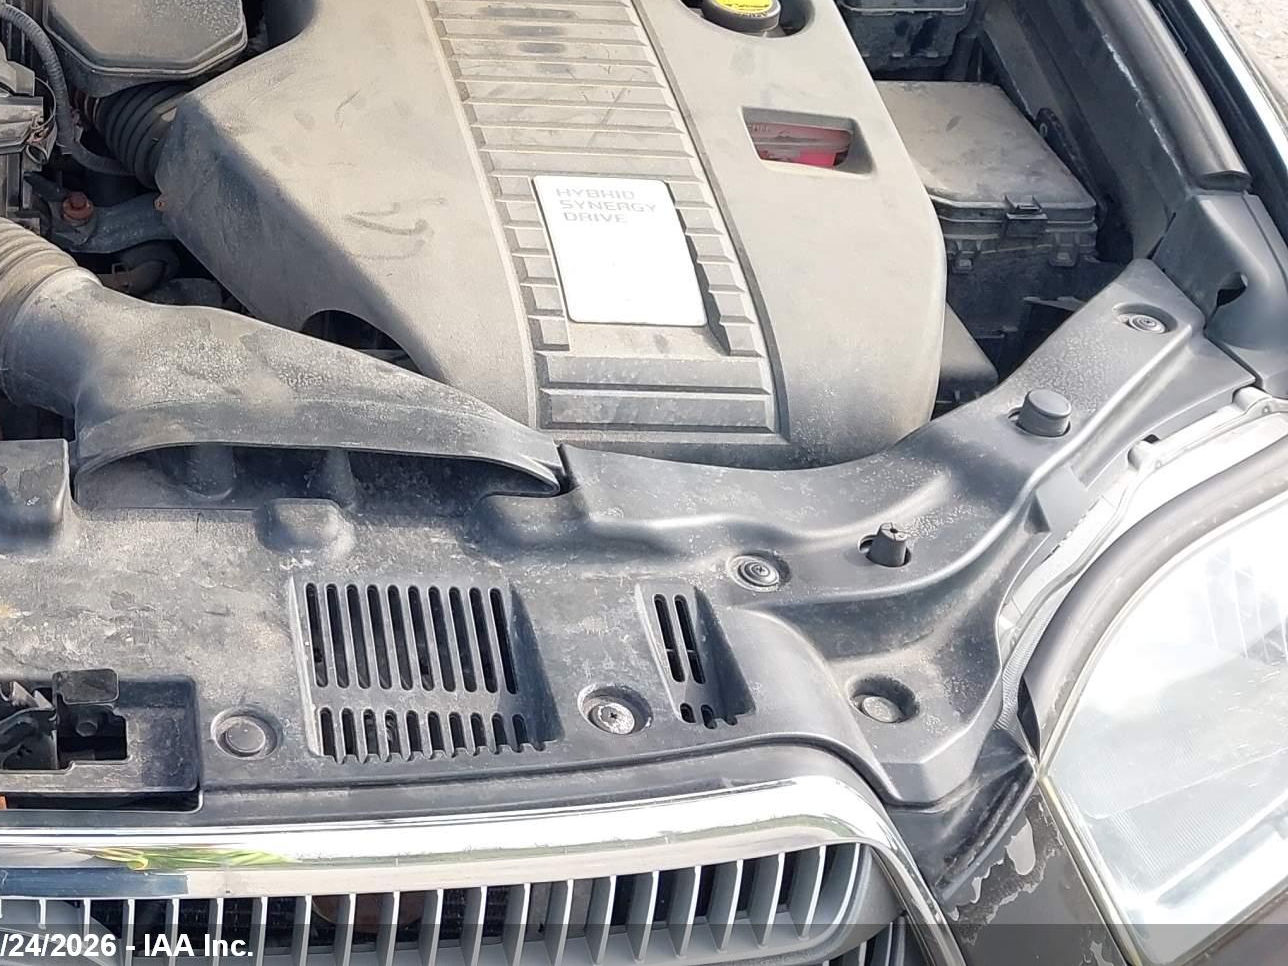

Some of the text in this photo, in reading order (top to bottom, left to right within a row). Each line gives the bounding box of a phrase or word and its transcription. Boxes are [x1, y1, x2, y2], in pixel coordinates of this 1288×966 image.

[556, 187, 635, 200] HYBRID
[559, 200, 657, 213] SYNERGY
[563, 212, 628, 224] DRIVE
